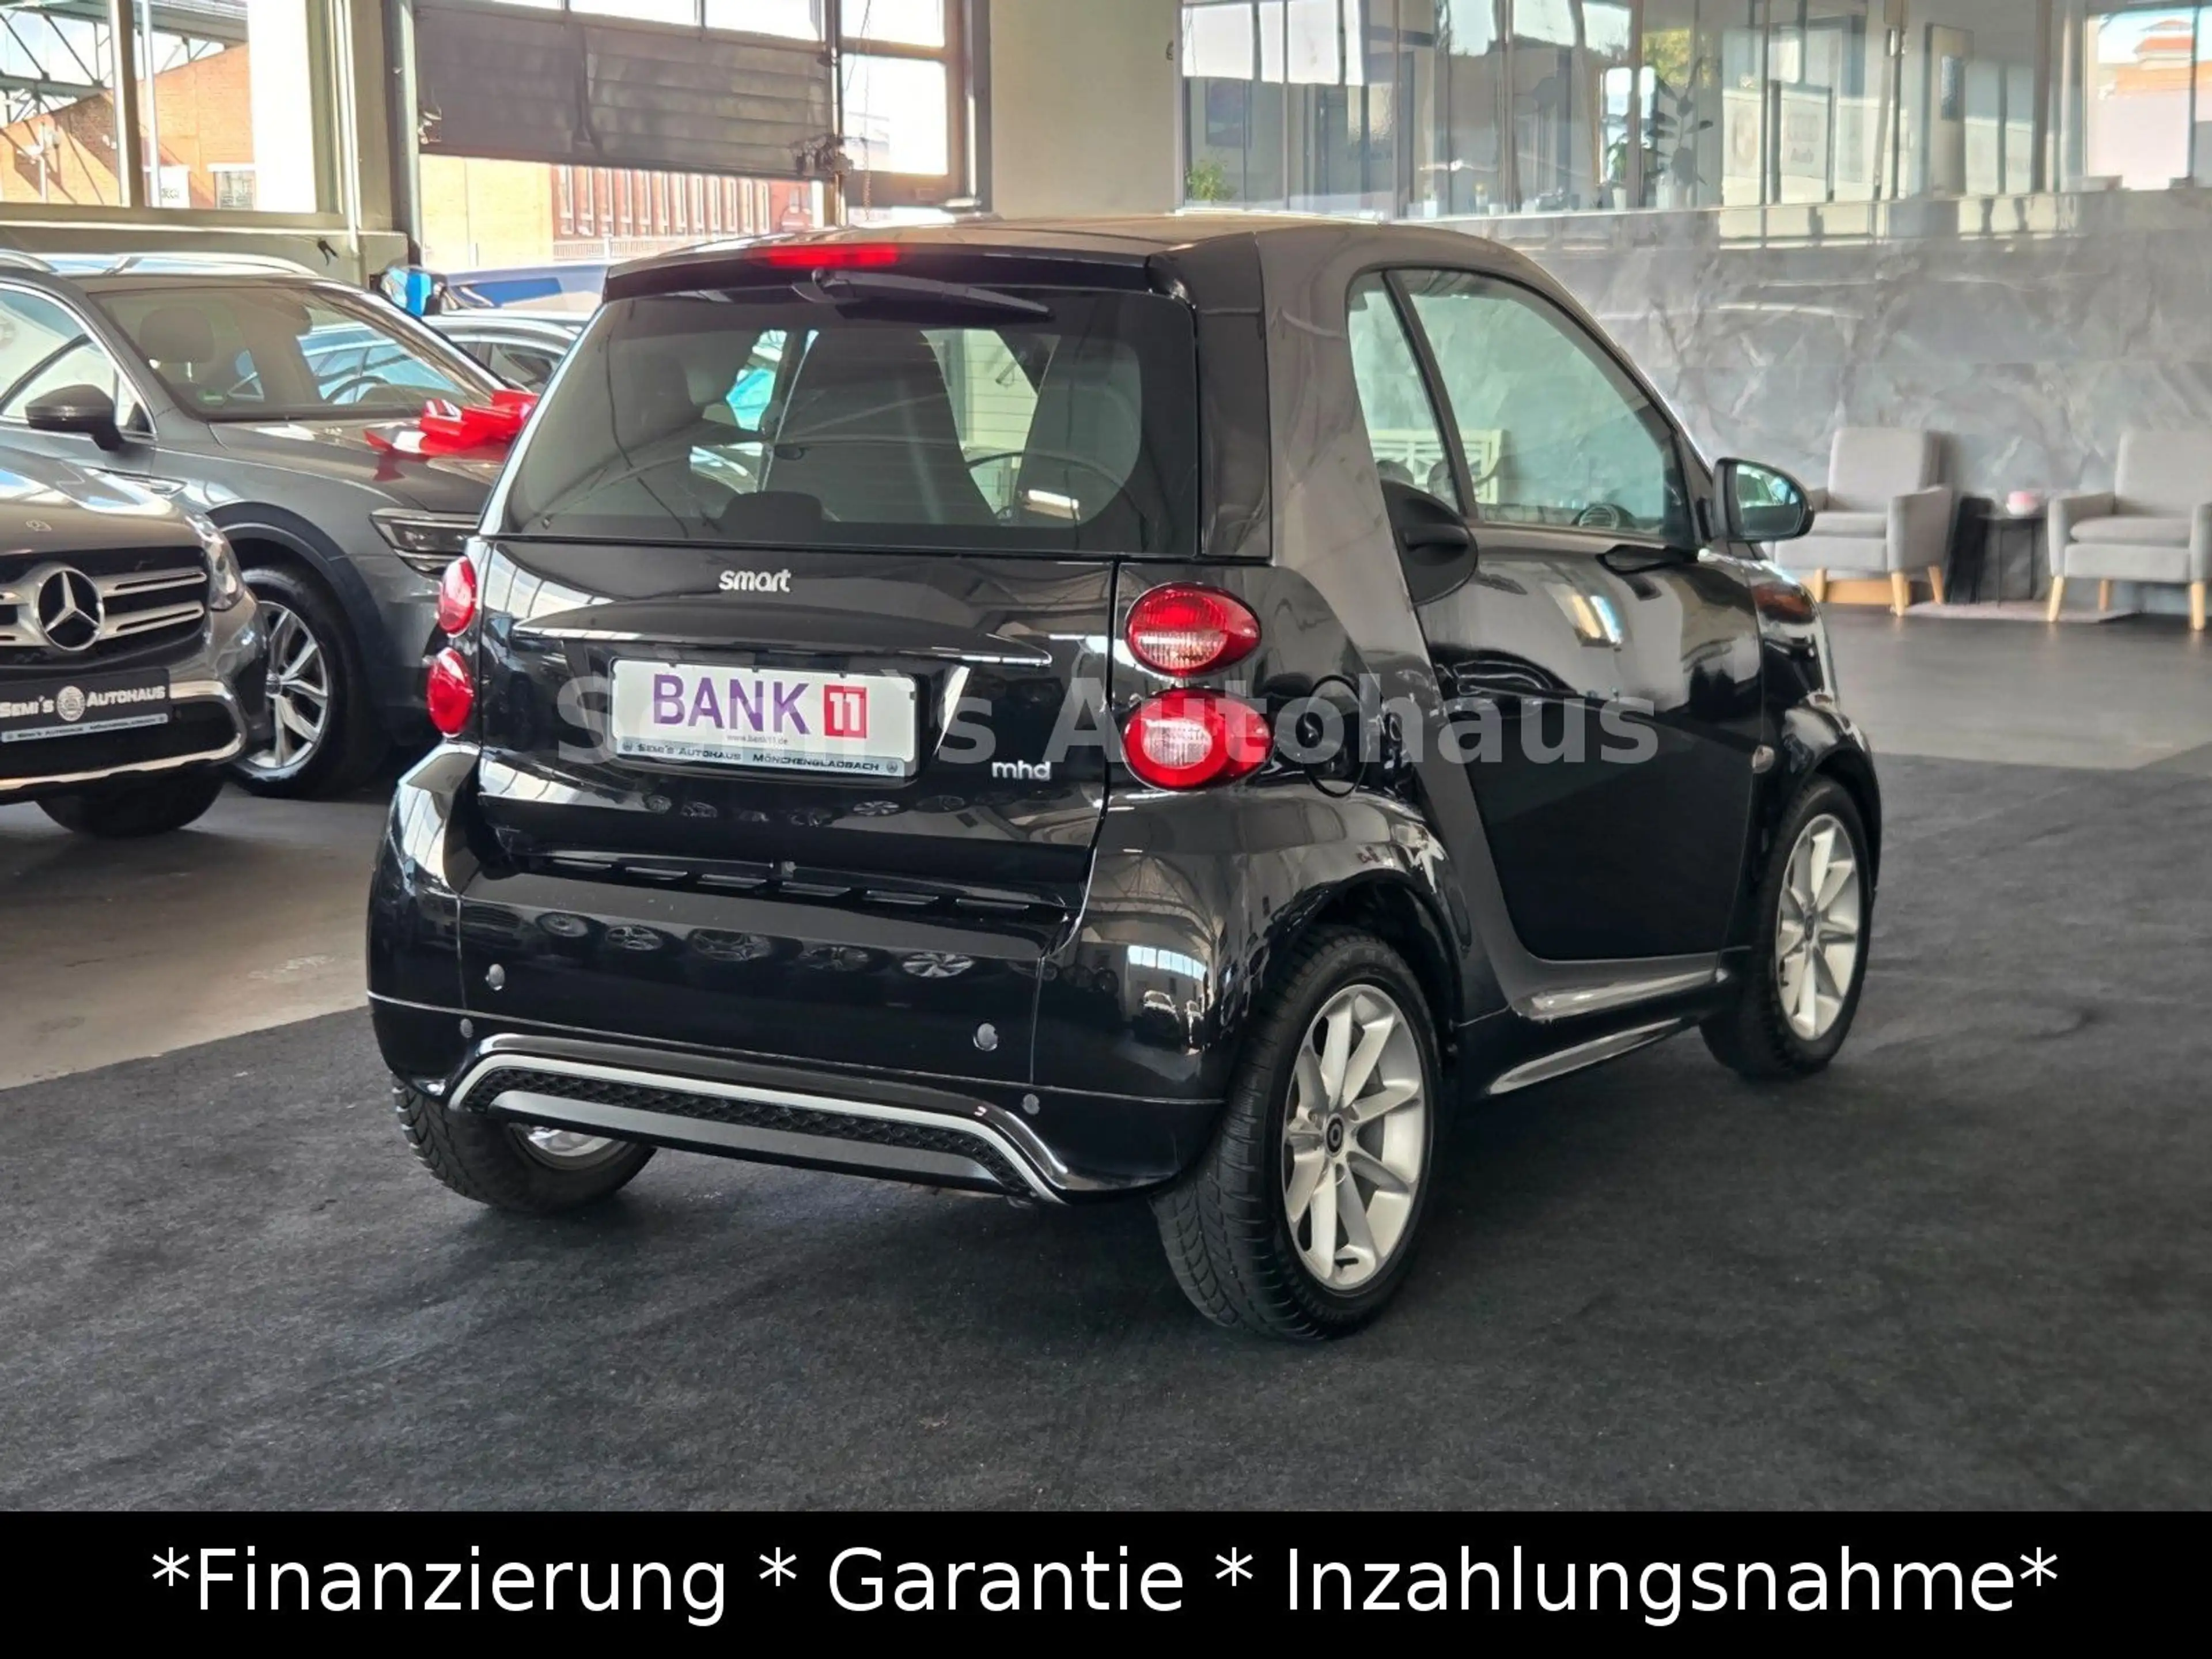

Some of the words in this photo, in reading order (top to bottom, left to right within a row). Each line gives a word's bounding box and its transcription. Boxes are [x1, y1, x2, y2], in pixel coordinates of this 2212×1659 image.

[719, 569, 791, 593] smart
[653, 673, 810, 734] BANK
[829, 692, 861, 732] 11
[992, 759, 1051, 781] mhd
